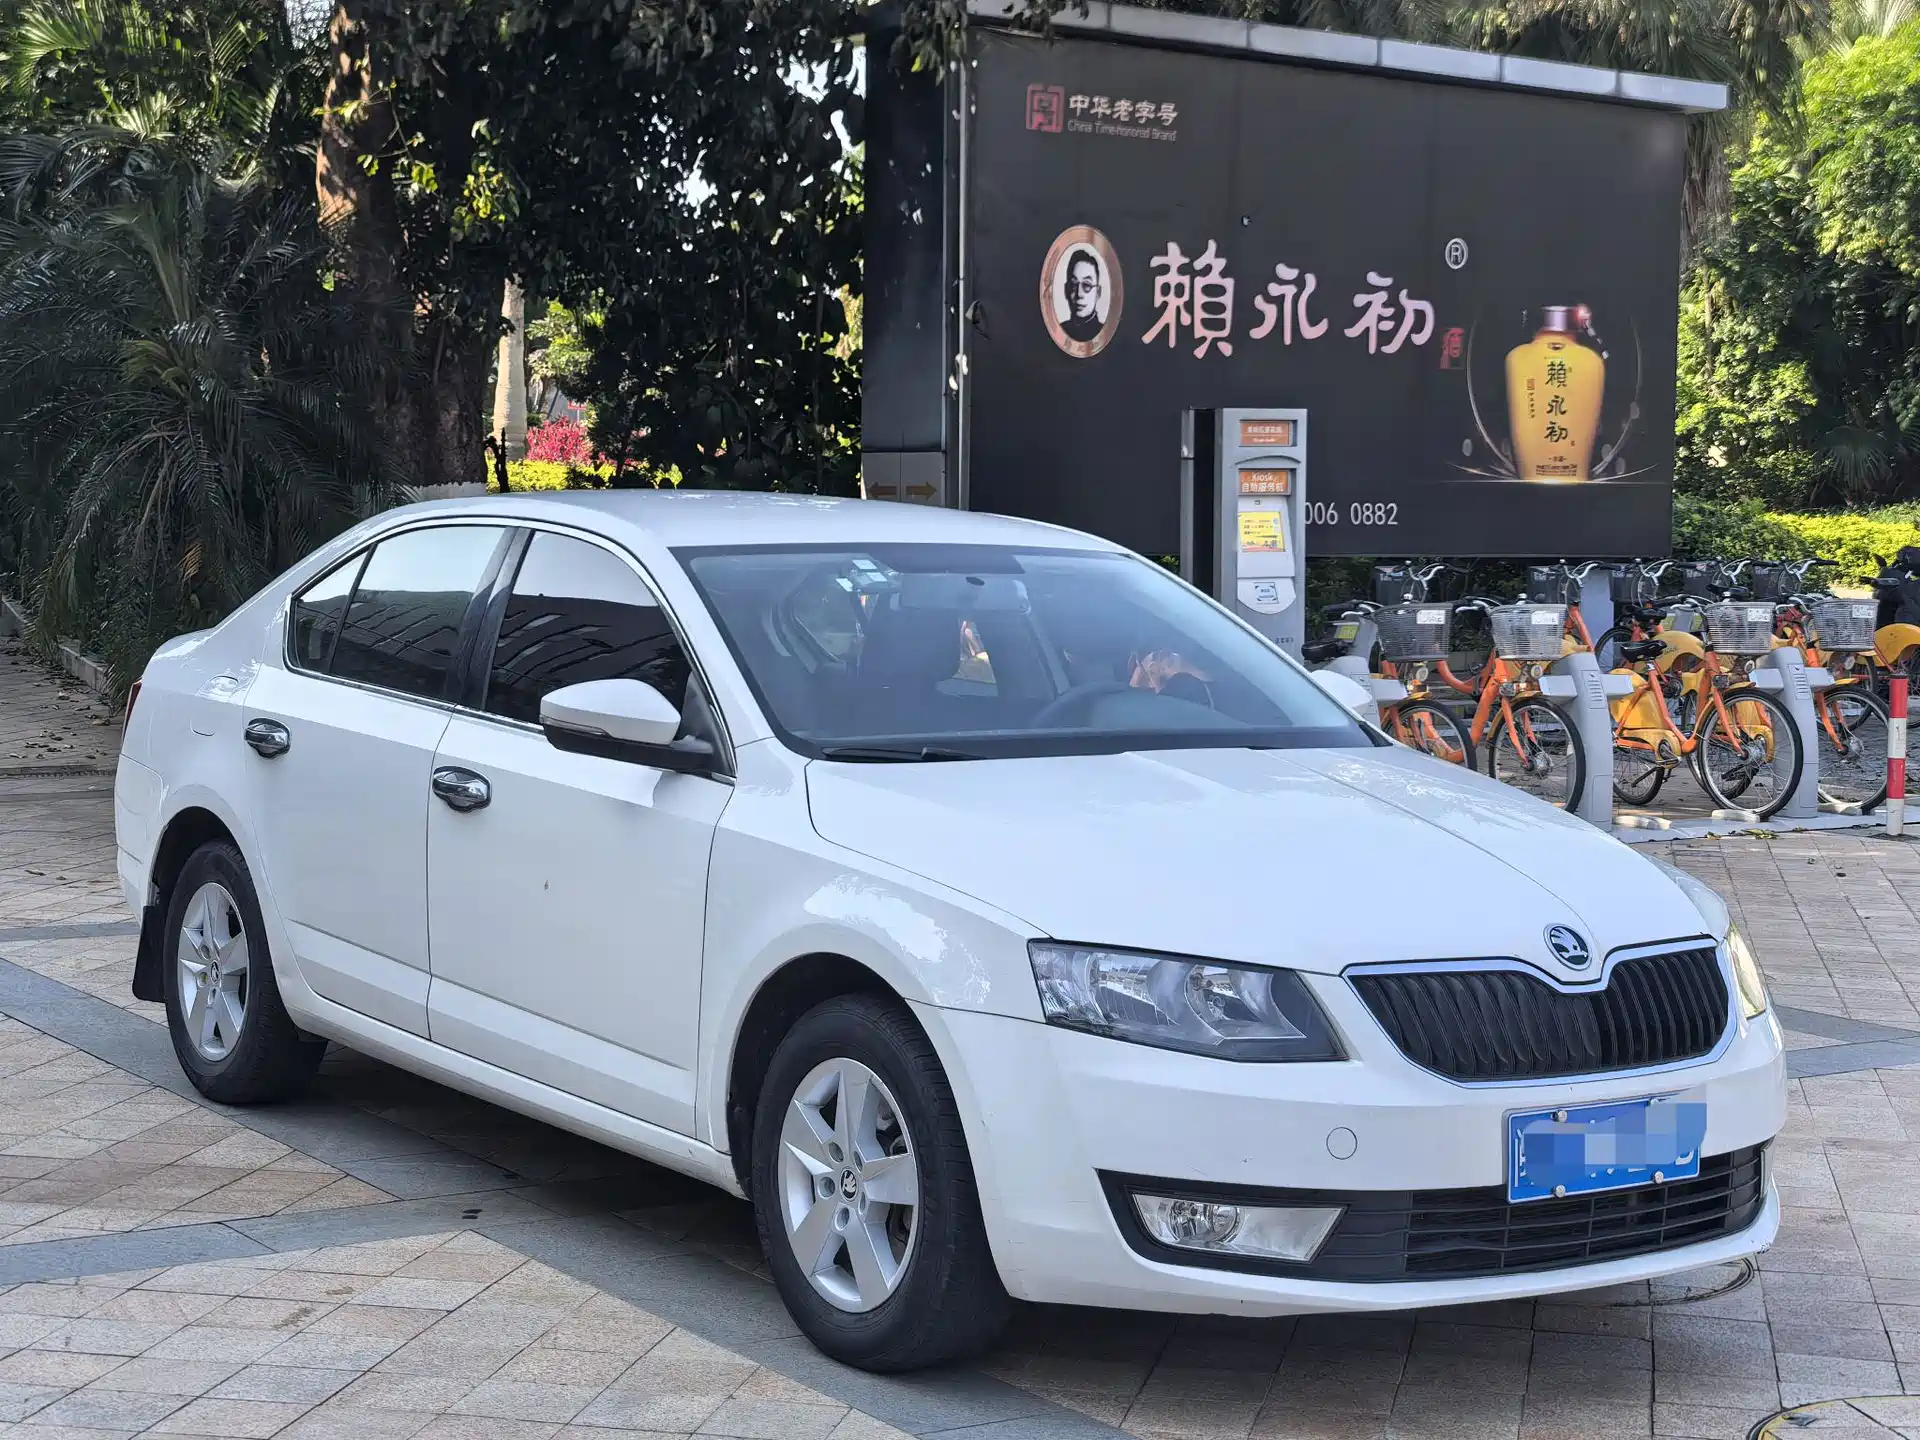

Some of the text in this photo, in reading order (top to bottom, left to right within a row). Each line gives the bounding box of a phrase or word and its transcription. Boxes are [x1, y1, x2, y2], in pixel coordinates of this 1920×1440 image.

[1068, 94, 1179, 126] 中华老字号
[1067, 119, 1093, 133] China
[1151, 128, 1177, 141] Brand
[1350, 502, 1398, 525] 0882
